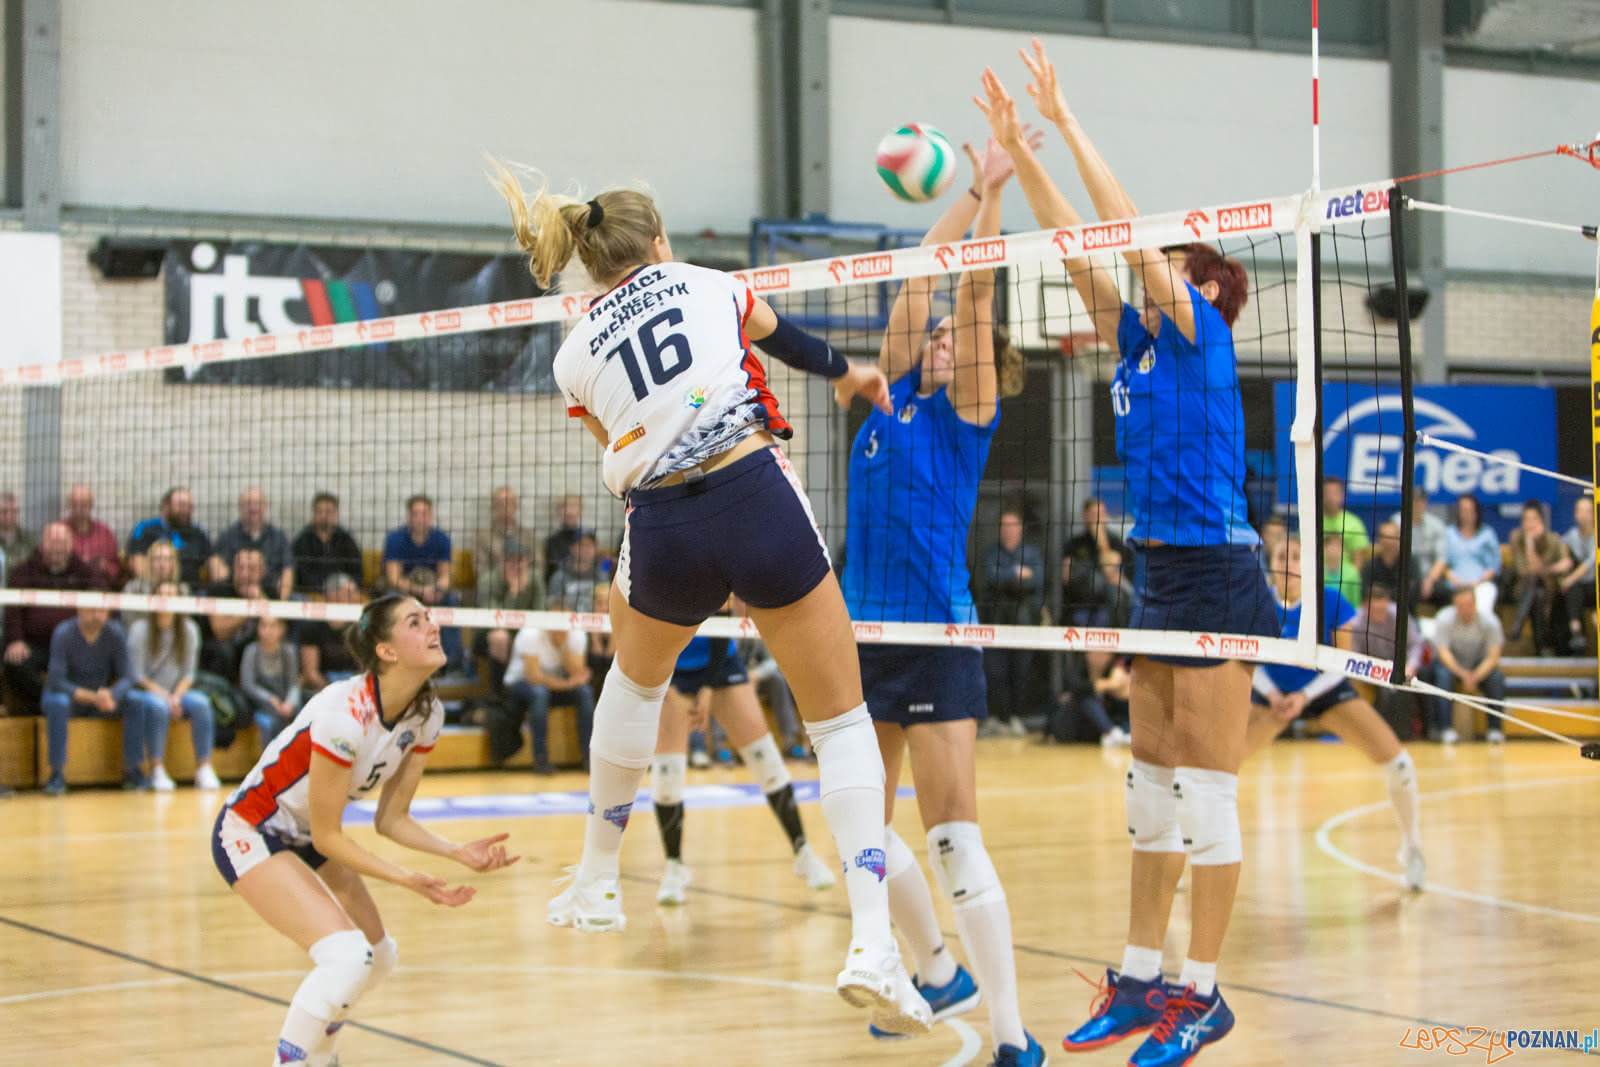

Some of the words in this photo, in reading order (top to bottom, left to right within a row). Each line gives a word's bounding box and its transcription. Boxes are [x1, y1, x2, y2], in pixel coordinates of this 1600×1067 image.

[1217, 204, 1272, 233] ORLEN
[1326, 189, 1390, 219] netex
[1082, 222, 1131, 250] ORLEN
[853, 255, 893, 279] ORLEN
[962, 240, 1005, 265] ORLEN
[605, 307, 693, 403] 16
[1350, 433, 1521, 495] Enea
[1345, 657, 1392, 682] netex
[356, 760, 387, 793] 5
